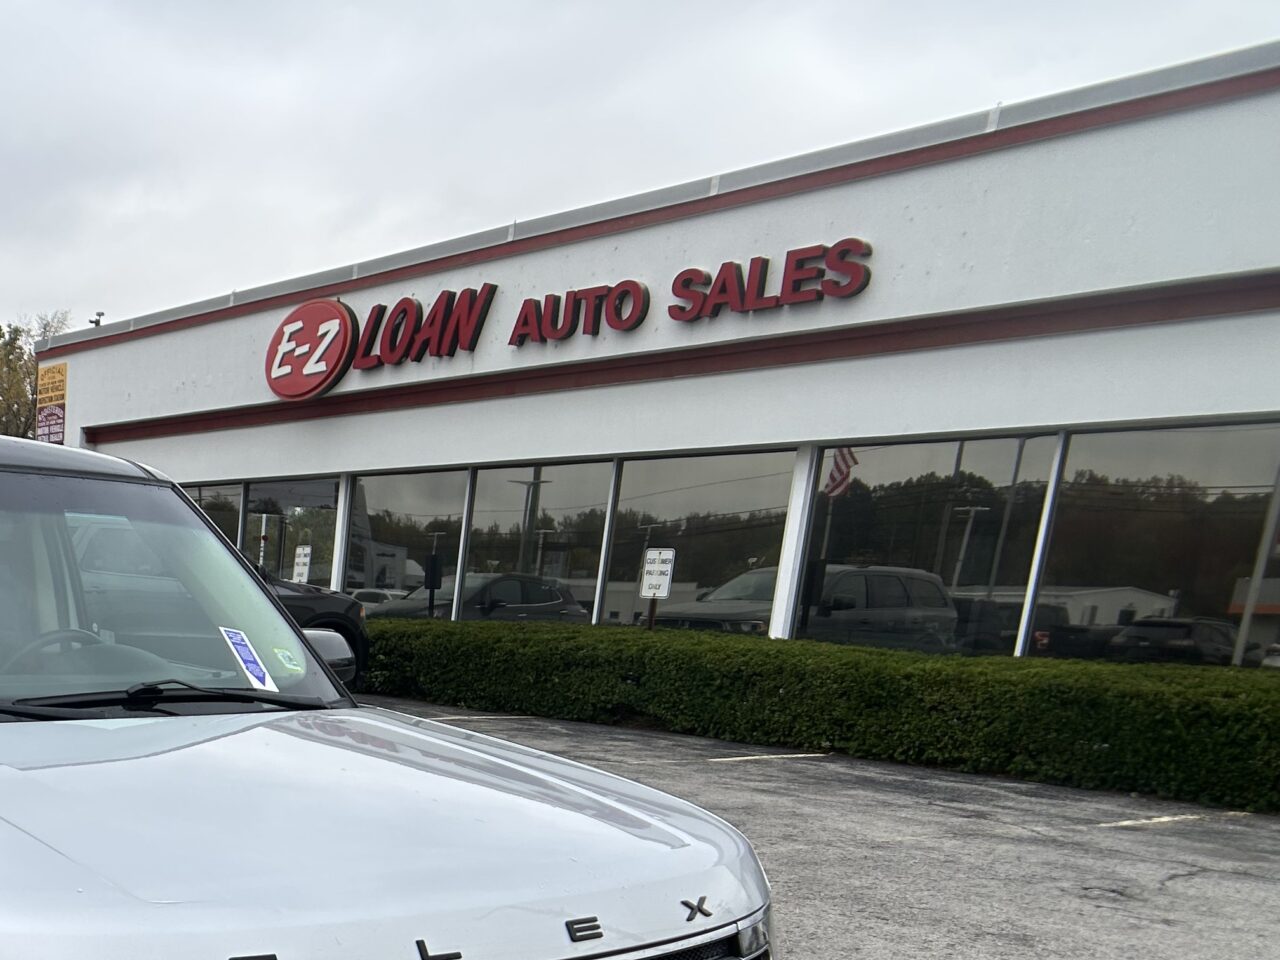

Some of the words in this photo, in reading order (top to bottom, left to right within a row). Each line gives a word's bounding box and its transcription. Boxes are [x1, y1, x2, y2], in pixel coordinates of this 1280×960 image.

[271, 318, 341, 380] E-Z
[352, 283, 499, 370] LOAN
[508, 278, 649, 346] AUTO
[667, 237, 873, 322] SALES
